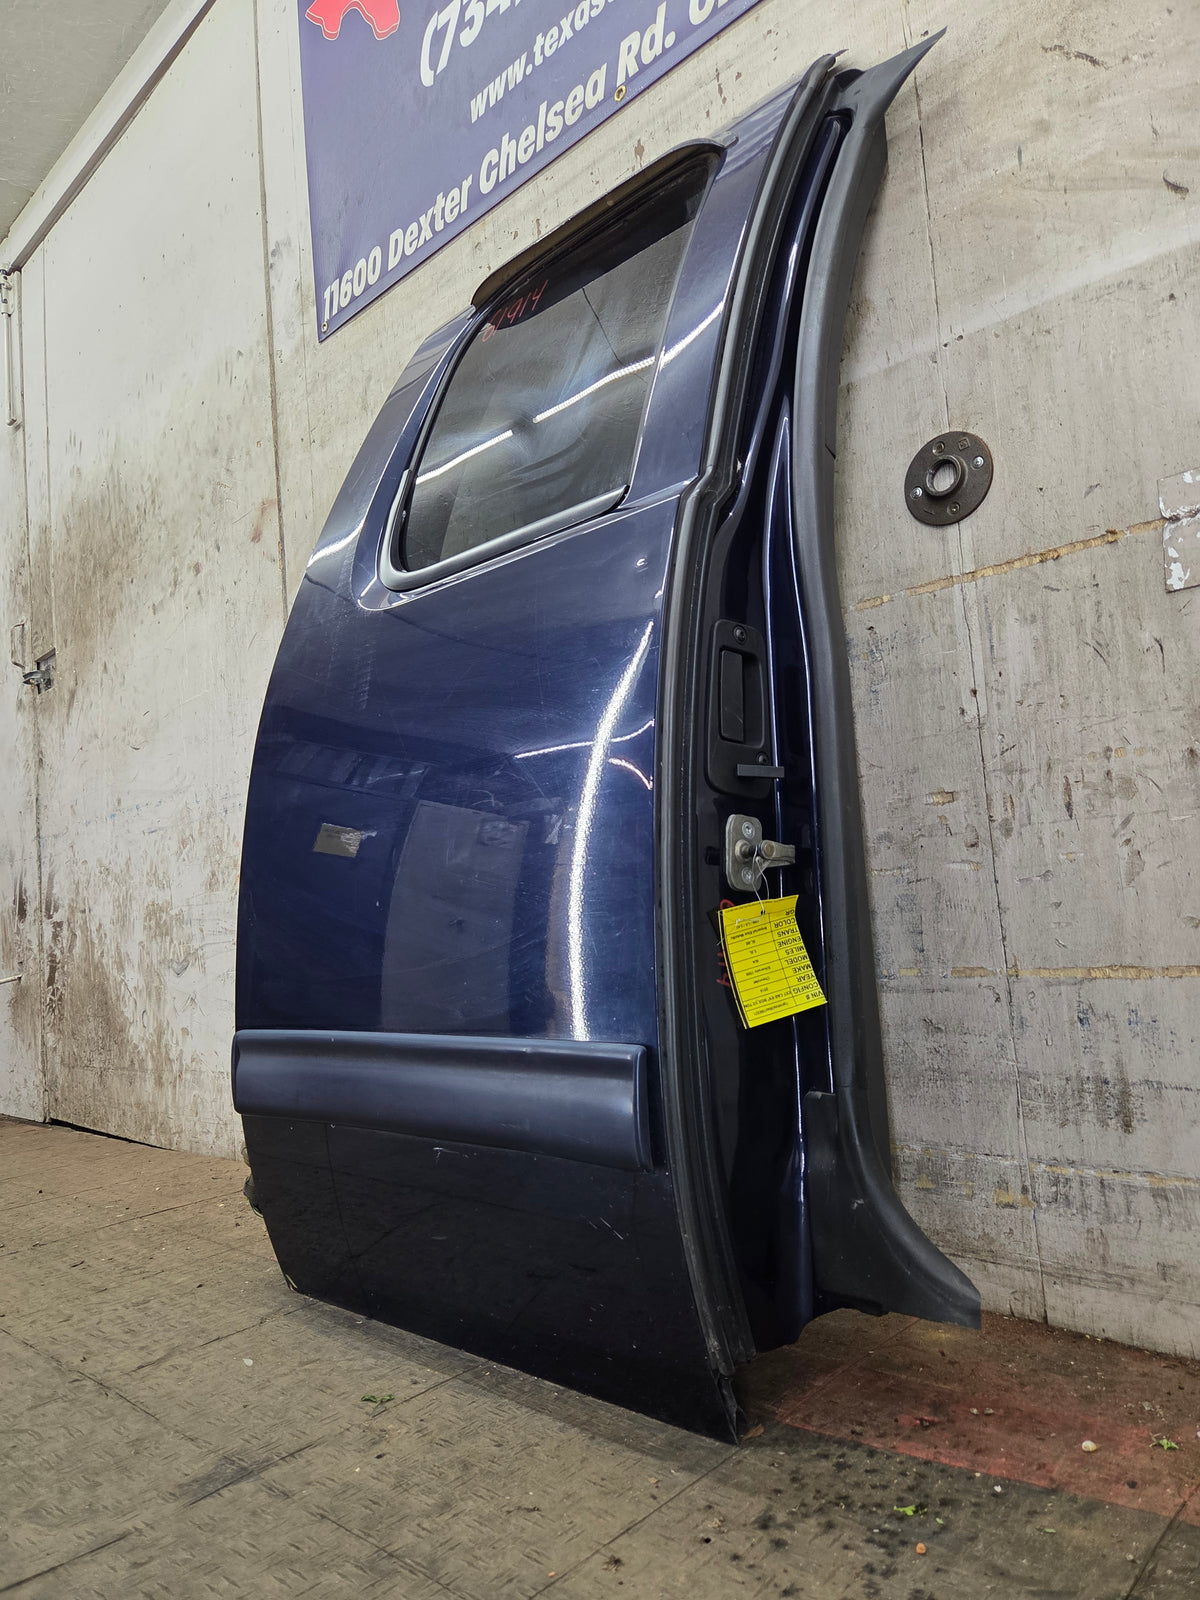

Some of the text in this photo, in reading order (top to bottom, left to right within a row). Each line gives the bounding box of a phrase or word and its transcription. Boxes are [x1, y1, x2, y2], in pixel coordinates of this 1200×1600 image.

[470, 0, 615, 124] www.texas
[324, 1, 676, 322] 11600 Dexter Chelsea Rd.
[773, 917, 796, 929] COLOR
[776, 926, 799, 938] TRANS
[777, 936, 802, 948] ENGINE
[784, 945, 805, 956] MILES
[784, 954, 808, 965] MODEL
[792, 963, 812, 974] MAKE
[796, 972, 816, 983] YEAR
[792, 981, 819, 994] CONFIG
[811, 990, 824, 999] VIN
